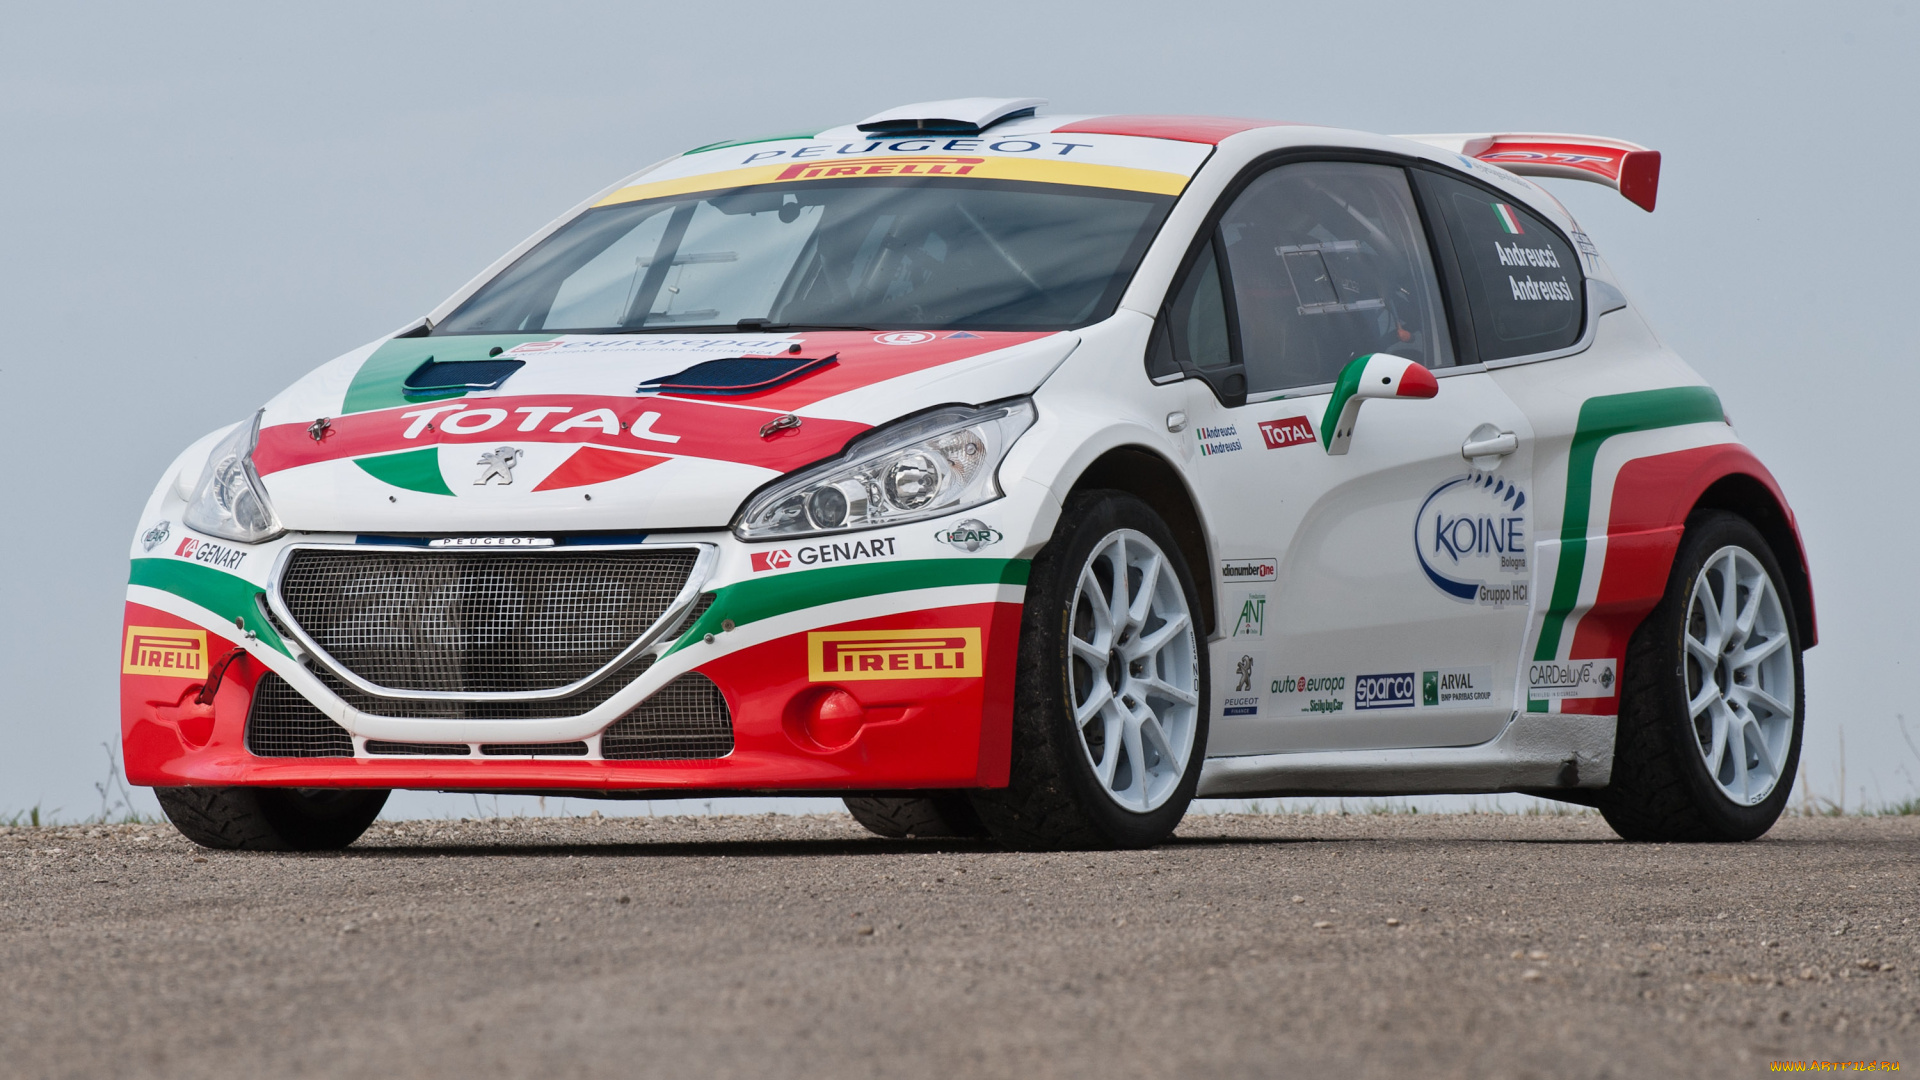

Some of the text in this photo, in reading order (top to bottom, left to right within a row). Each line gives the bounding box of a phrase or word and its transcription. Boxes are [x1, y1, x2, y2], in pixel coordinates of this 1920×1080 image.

[741, 139, 1093, 165] PEUGEOT
[775, 157, 985, 181] PIRELLI
[1494, 241, 1560, 268] Andreucci
[1508, 275, 1574, 301] Andreussi
[401, 403, 681, 444] TOTAL
[1206, 424, 1238, 439] Andreucci
[1261, 423, 1314, 445] TOTAL
[1210, 438, 1243, 455] Andreussi
[443, 537, 535, 545] PEUGEOT
[947, 530, 991, 542] ICAR
[195, 542, 248, 571] GENART
[797, 537, 896, 565] GENART
[1501, 556, 1526, 569] Bologna
[1479, 585, 1528, 604] Gruppo HCI
[1232, 600, 1266, 638] ANT
[130, 634, 200, 670] PIRELLI
[823, 637, 967, 672] PIRELLI
[1271, 676, 1296, 694] auto
[1440, 673, 1474, 690] ARVAL
[1529, 664, 1592, 685] CARDeluxe
[1224, 698, 1259, 706] PEUGEOT
[1356, 676, 1414, 708] sparco
[1441, 691, 1491, 702] BNP PARIBAS GROUP
